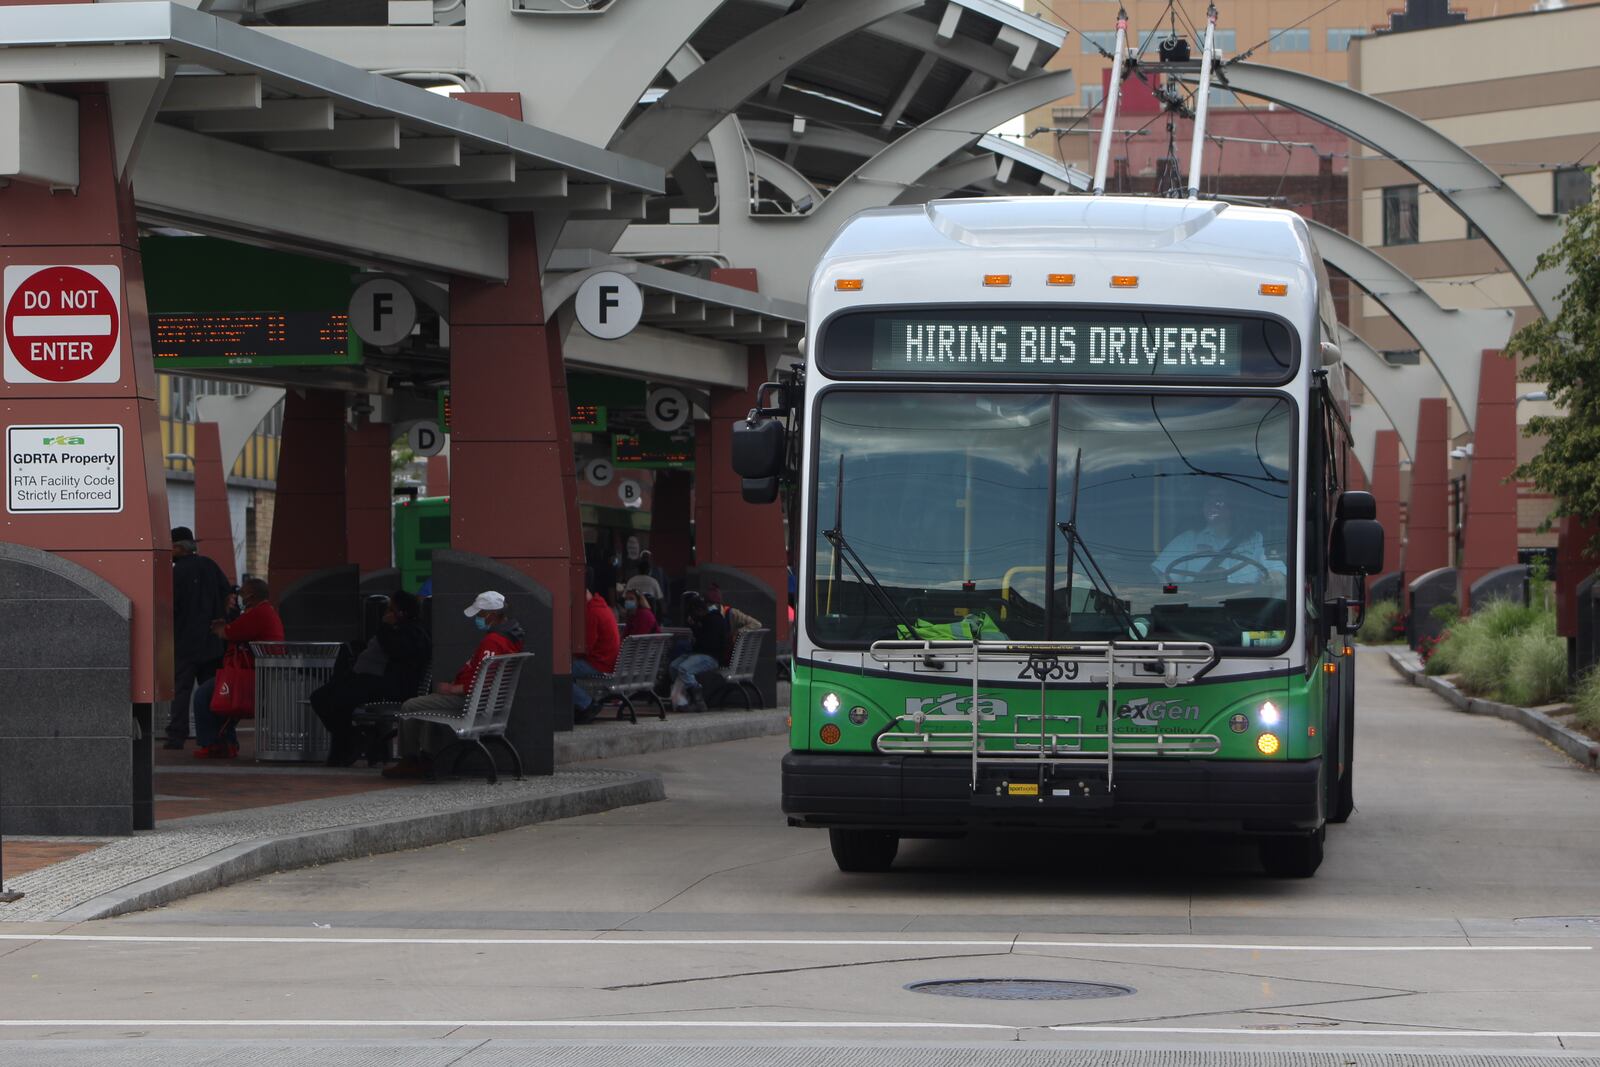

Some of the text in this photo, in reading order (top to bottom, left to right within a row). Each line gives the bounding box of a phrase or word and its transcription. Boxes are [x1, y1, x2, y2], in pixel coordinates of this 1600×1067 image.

[24, 289, 98, 309] DO NOT
[599, 285, 619, 325] F
[372, 292, 393, 332] F
[30, 341, 94, 362] ENTER
[906, 324, 1226, 366] HIRING BUS DRIVERS!
[654, 397, 680, 422] G
[42, 435, 85, 446] rta
[418, 428, 435, 450] D
[13, 452, 116, 467] GDRTA Property
[14, 474, 115, 489] RTA Facility Code
[592, 463, 607, 481] C
[17, 488, 112, 503] Strictly Enforced
[624, 484, 635, 499] B
[905, 692, 1009, 716] rta
[1095, 699, 1200, 721] NexGen
